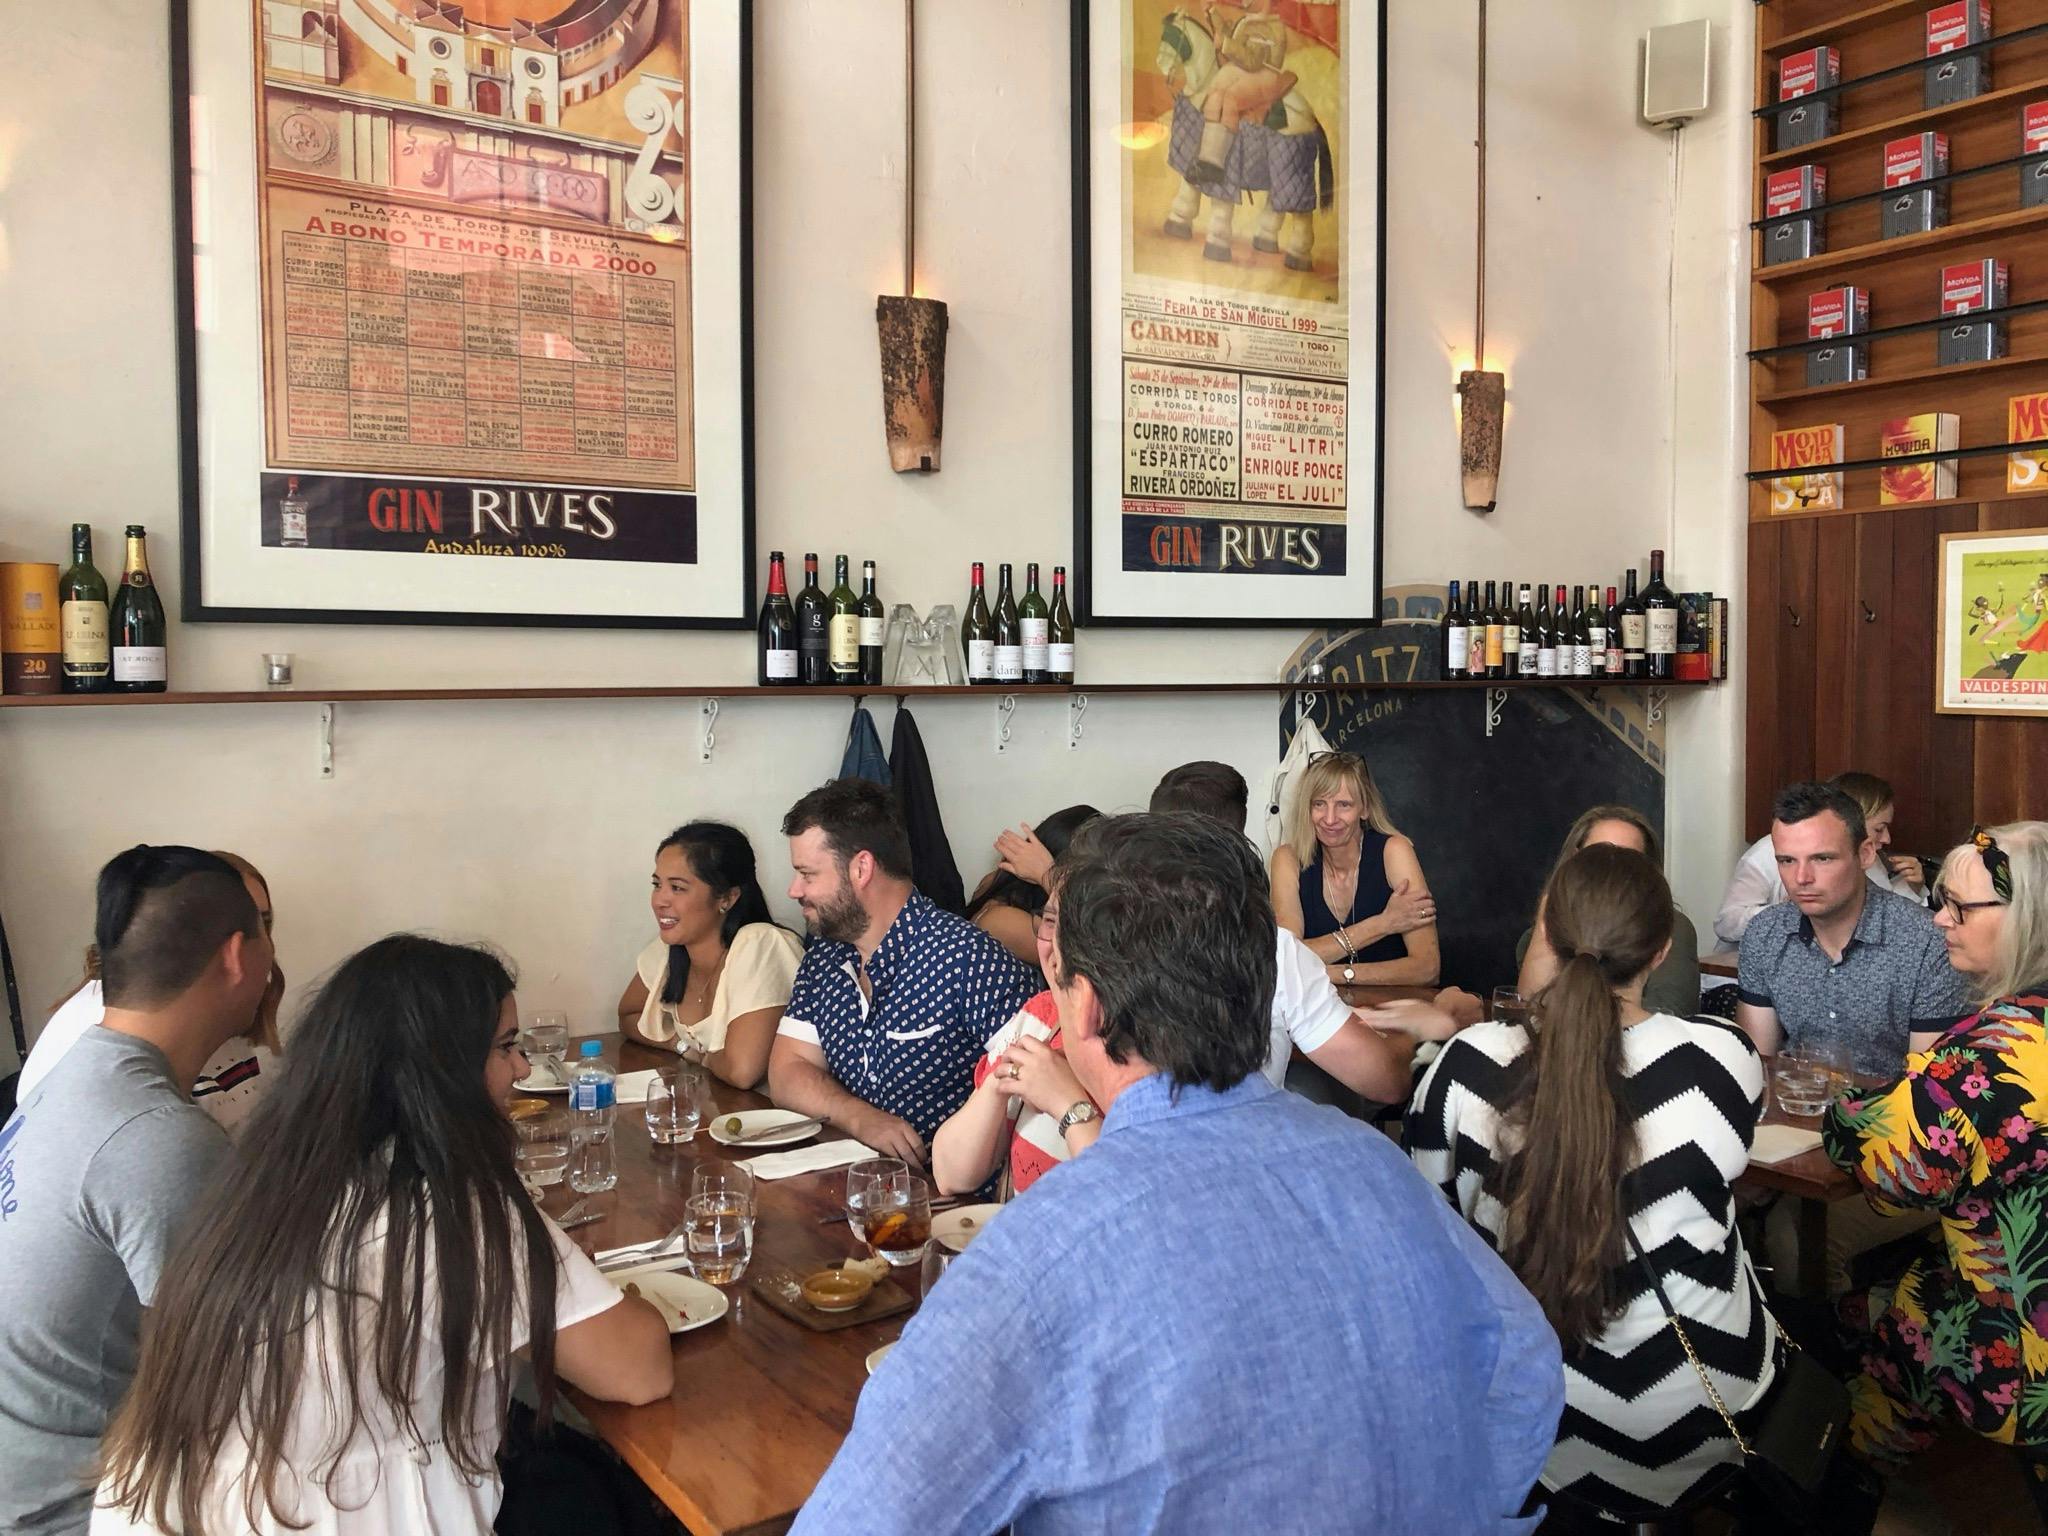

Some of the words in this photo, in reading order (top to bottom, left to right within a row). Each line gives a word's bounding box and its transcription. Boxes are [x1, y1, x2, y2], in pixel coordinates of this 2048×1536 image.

[350, 202, 412, 220] PLAZA
[423, 214, 444, 224] DE
[454, 217, 511, 234] TOROS
[520, 228, 541, 239] DE
[550, 230, 620, 250] SEVILLA
[306, 216, 407, 244] ABONO
[419, 231, 581, 266] TEMPORADA
[593, 254, 657, 276] 2000
[1164, 299, 1198, 317] FERIA
[1203, 306, 1217, 319] DE
[1220, 307, 1244, 323] SAN
[1247, 310, 1288, 329] MIGUEL
[1292, 317, 1318, 333] 1999
[1130, 320, 1220, 348] CARMEN
[1307, 342, 1329, 352] TORO
[1308, 358, 1342, 370] MONTES
[1130, 384, 1180, 399] CORRIDA
[1185, 389, 1198, 401] DE
[1203, 392, 1238, 405] TOROS
[1246, 396, 1292, 410] CORRIDA
[1296, 401, 1308, 412] DE
[1312, 403, 1344, 415] TOROS
[1133, 422, 1178, 442] CURRO
[1183, 427, 1234, 447] ROMERO
[1246, 432, 1276, 443] MIGUEL
[1146, 442, 1166, 451] JUAN
[1168, 444, 1202, 454] ANTONIO
[1204, 447, 1222, 455] RUIZ
[1251, 442, 1271, 452] BAEZ
[1885, 438, 1931, 457] MOVIDA
[1162, 469, 1206, 480] FRANCISCO
[1245, 458, 1299, 477] ENRIQUE
[1304, 462, 1343, 480] PONCE
[1130, 475, 1176, 495] RIVERA
[1180, 476, 1236, 498] ORDOÑEZ
[1245, 482, 1269, 490] JULIAN
[1247, 491, 1267, 500] LOPEZ
[368, 487, 444, 534] GIN
[470, 487, 618, 540] RIVES
[425, 538, 515, 557] Andaluza
[522, 543, 567, 558] 100%
[1150, 524, 1202, 567] GIN
[1219, 524, 1322, 571] RIVES
[24, 659, 47, 674] 20
[1963, 680, 2048, 694] VALDESPIN
[1331, 697, 1403, 750] ARCELONA
